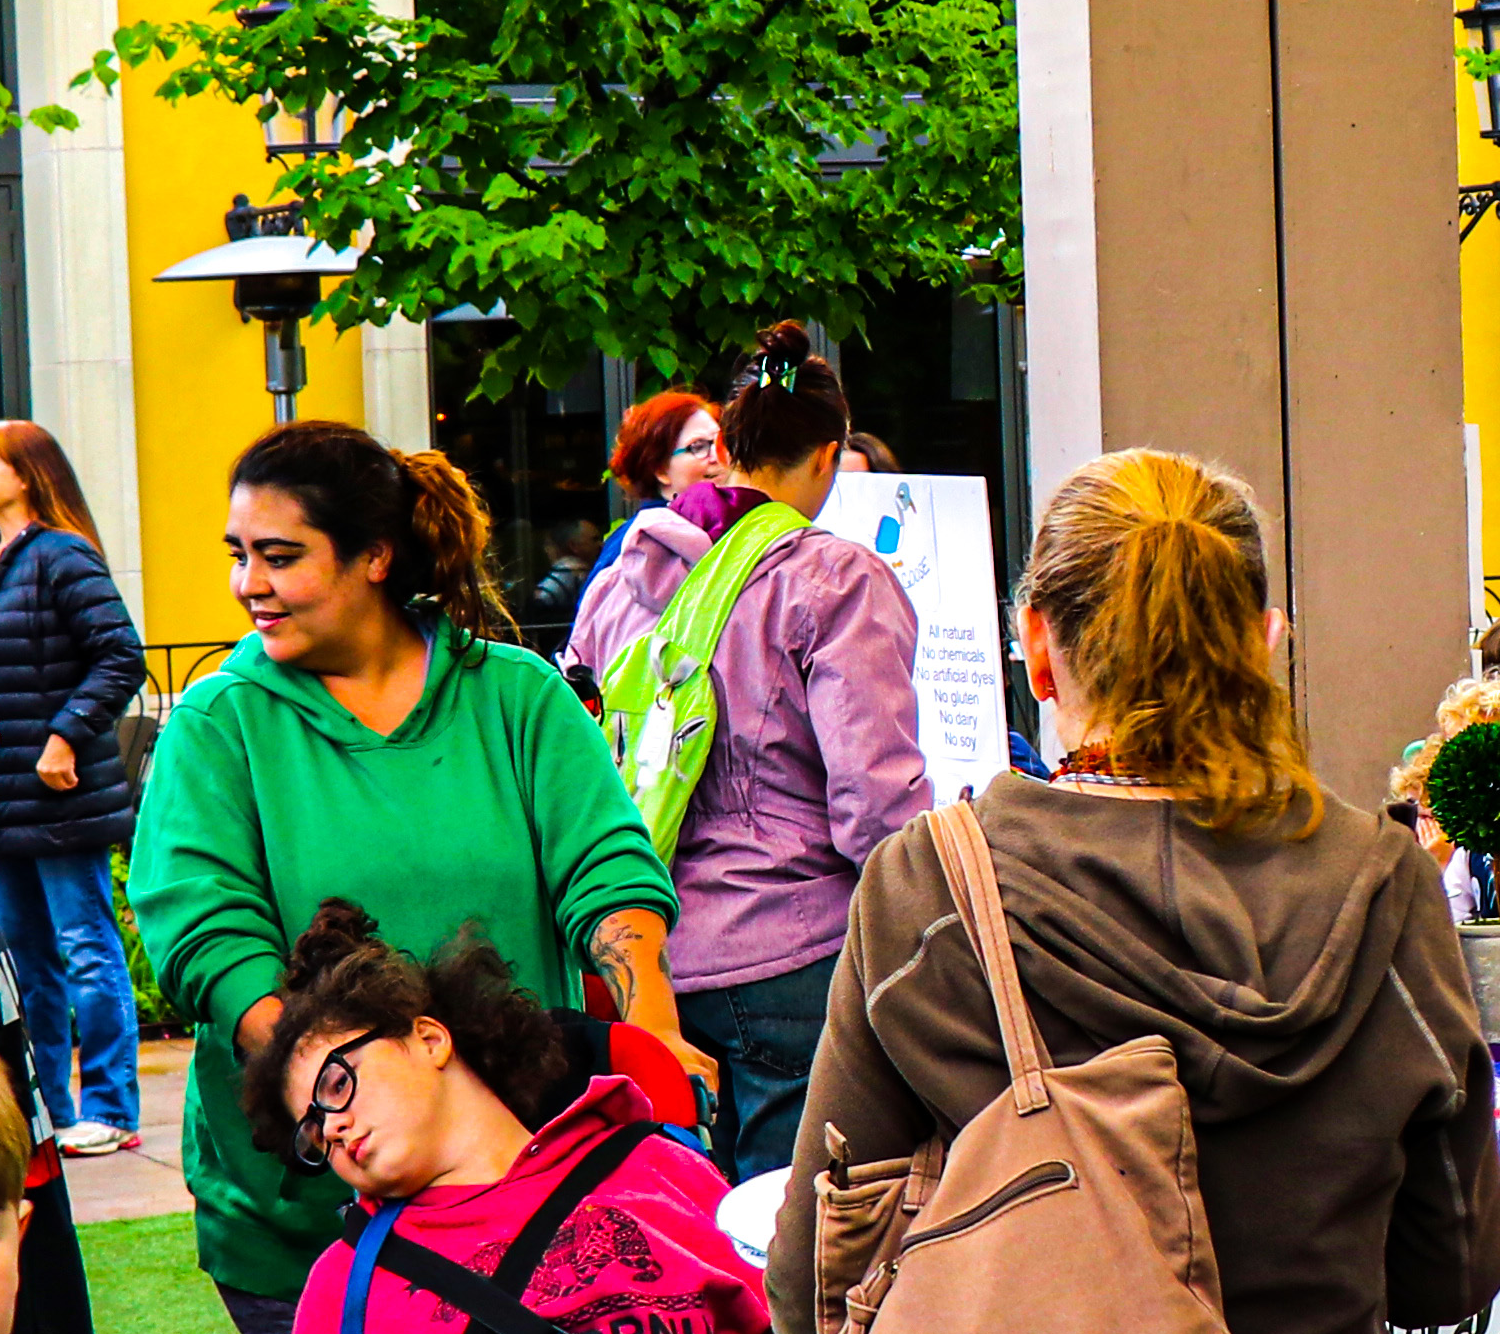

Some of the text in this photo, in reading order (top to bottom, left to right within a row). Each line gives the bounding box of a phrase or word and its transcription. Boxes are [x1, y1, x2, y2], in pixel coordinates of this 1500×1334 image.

[928, 624, 975, 641] All natural
[922, 646, 986, 663] No chemicals
[917, 666, 995, 688] No artificial dyes
[934, 689, 979, 707] No gluten
[939, 710, 978, 730] No dairy
[944, 732, 977, 751] No soy
